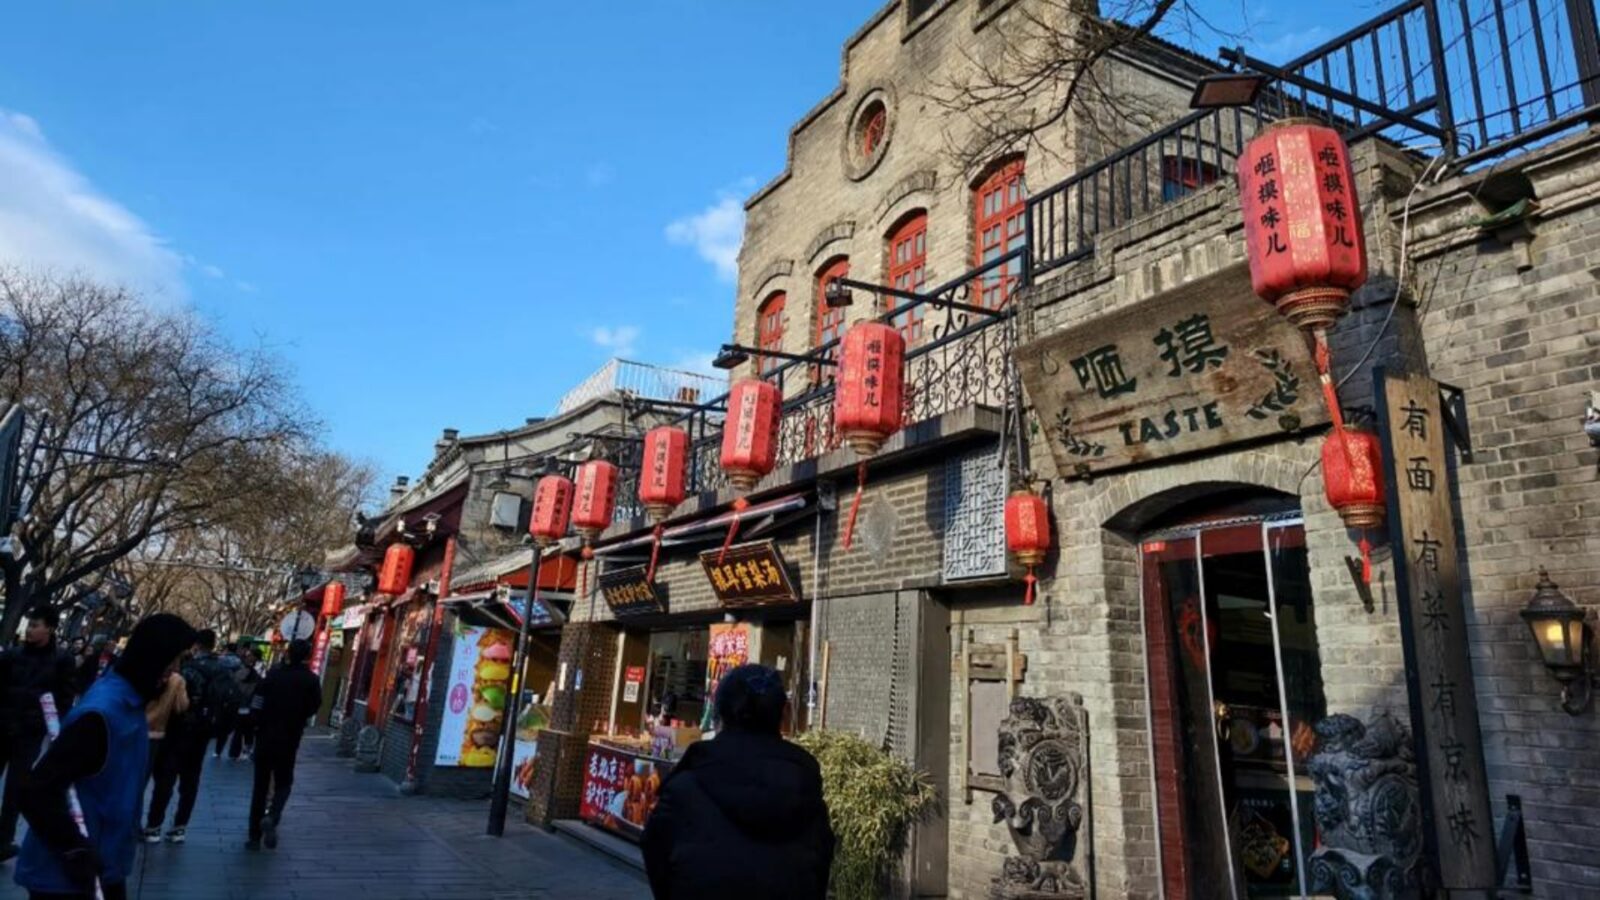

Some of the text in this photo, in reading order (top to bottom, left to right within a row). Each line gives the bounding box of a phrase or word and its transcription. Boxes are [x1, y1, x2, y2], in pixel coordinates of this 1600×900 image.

[1254, 152, 1288, 258] 咂摸味儿
[1318, 143, 1354, 248] 咂摸味儿
[1069, 313, 1229, 400] 咂摸
[1118, 401, 1223, 446] TASTE
